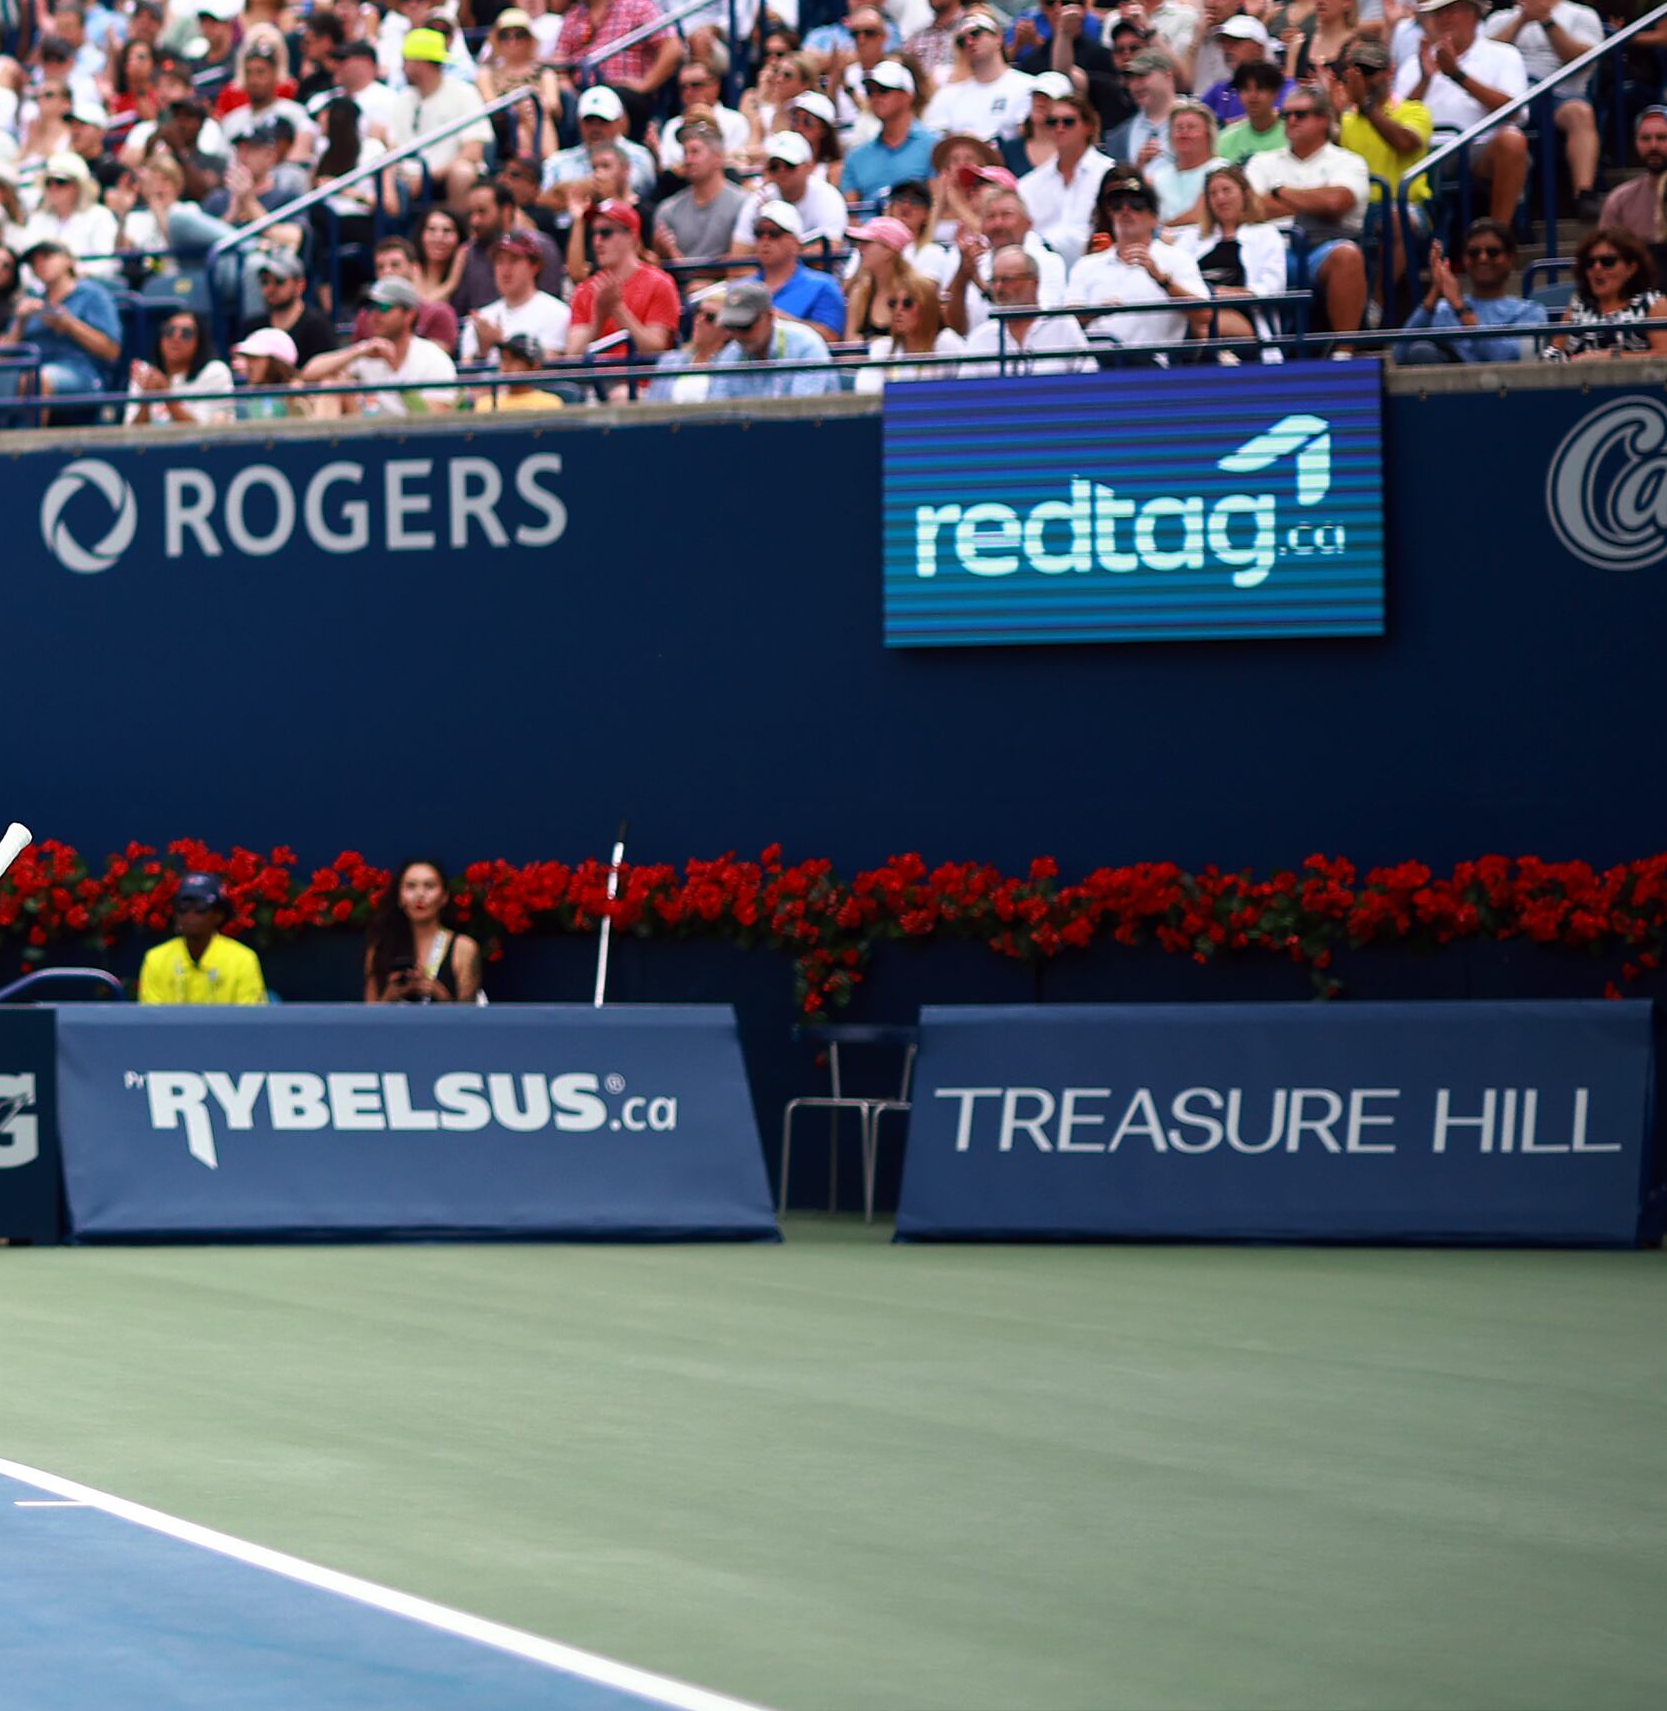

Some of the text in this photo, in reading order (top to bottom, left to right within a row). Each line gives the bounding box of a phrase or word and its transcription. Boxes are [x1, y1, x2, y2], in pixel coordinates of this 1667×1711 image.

[165, 454, 567, 557] ROGERS
[935, 1087, 1621, 1153] TREASURE HILL
